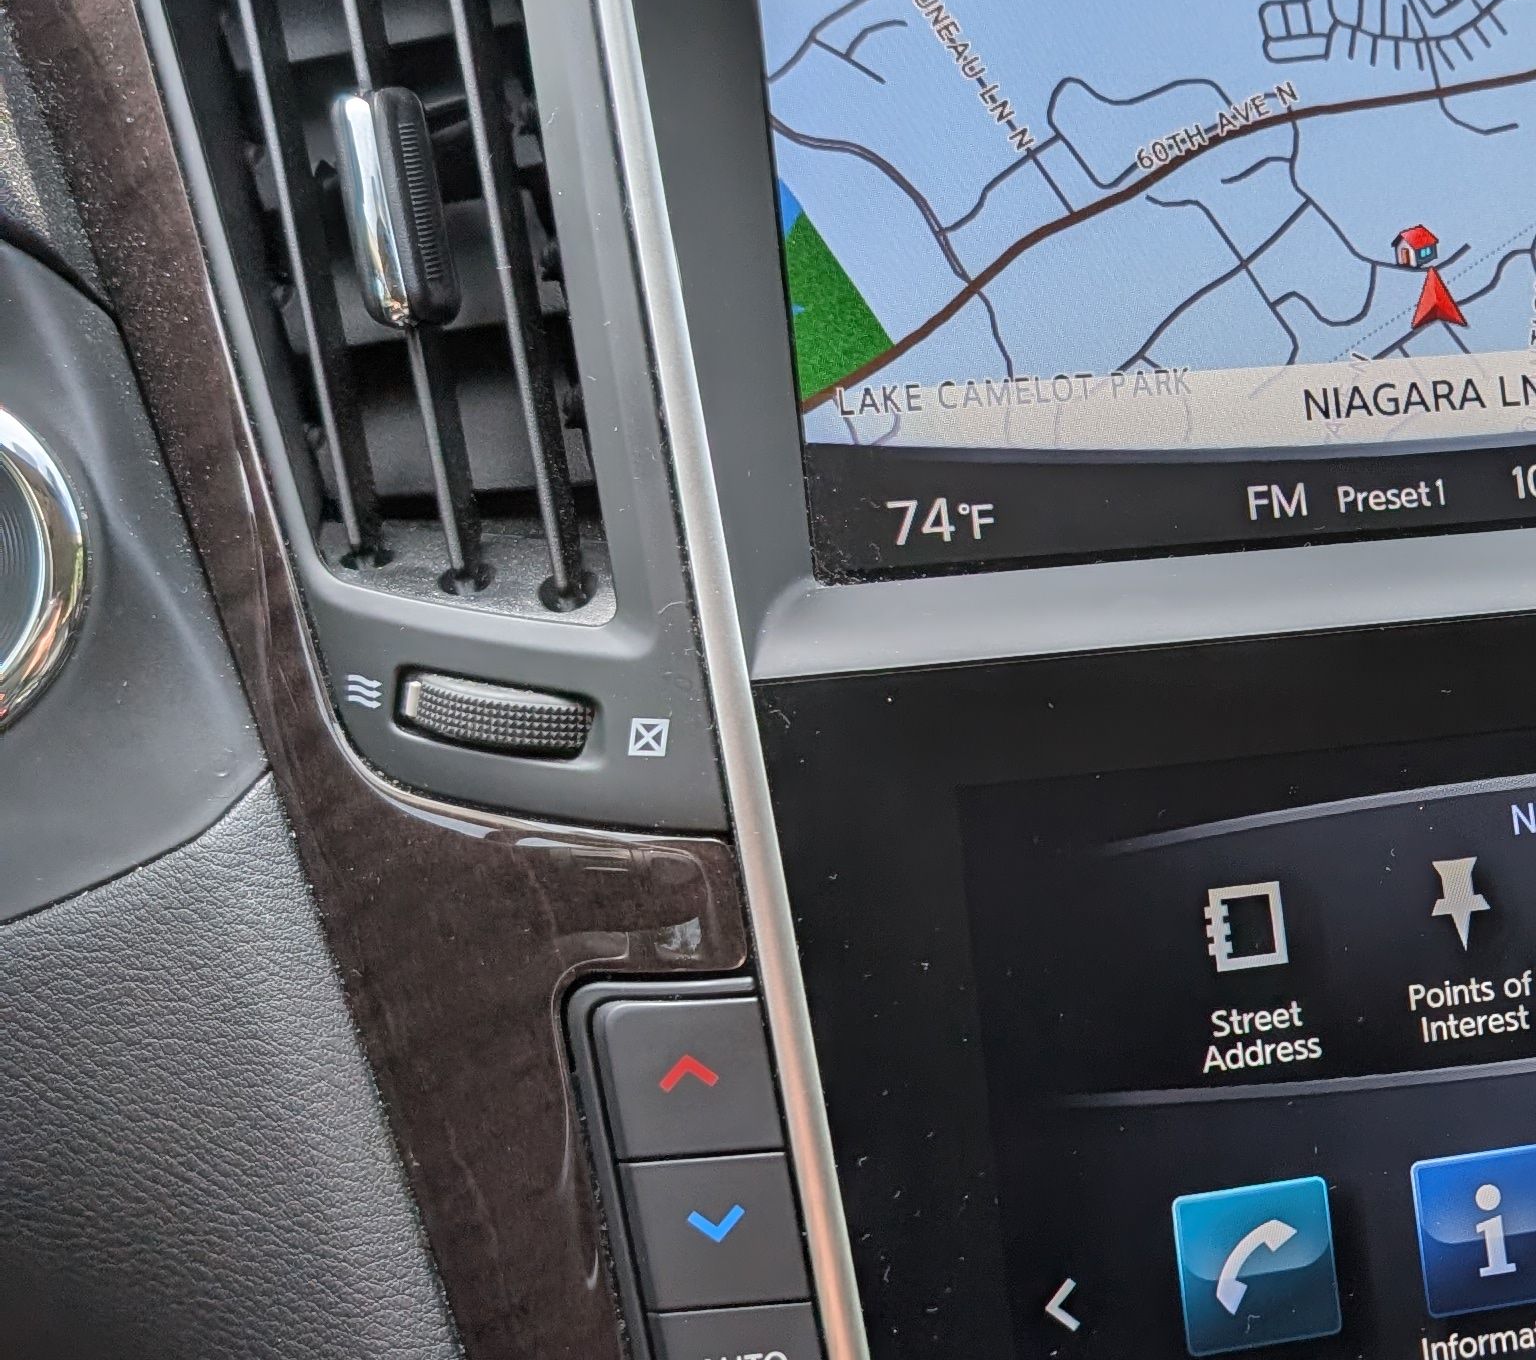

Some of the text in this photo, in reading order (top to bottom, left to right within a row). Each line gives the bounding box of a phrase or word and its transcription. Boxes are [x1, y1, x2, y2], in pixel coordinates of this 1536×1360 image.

[979, 83, 1015, 123] LN
[1008, 127, 1035, 151] N
[1136, 81, 1299, 170] 60TH AVE N
[836, 367, 1193, 418] LAKE CAMELOT PARK
[1302, 378, 1487, 421] NIAGARA
[886, 497, 995, 546] 74°F
[1247, 482, 1308, 521] FM
[1408, 969, 1533, 1011] Points of
[1211, 1000, 1303, 1038] Street
[1421, 999, 1530, 1043] Interest
[1202, 1031, 1323, 1074] Address
